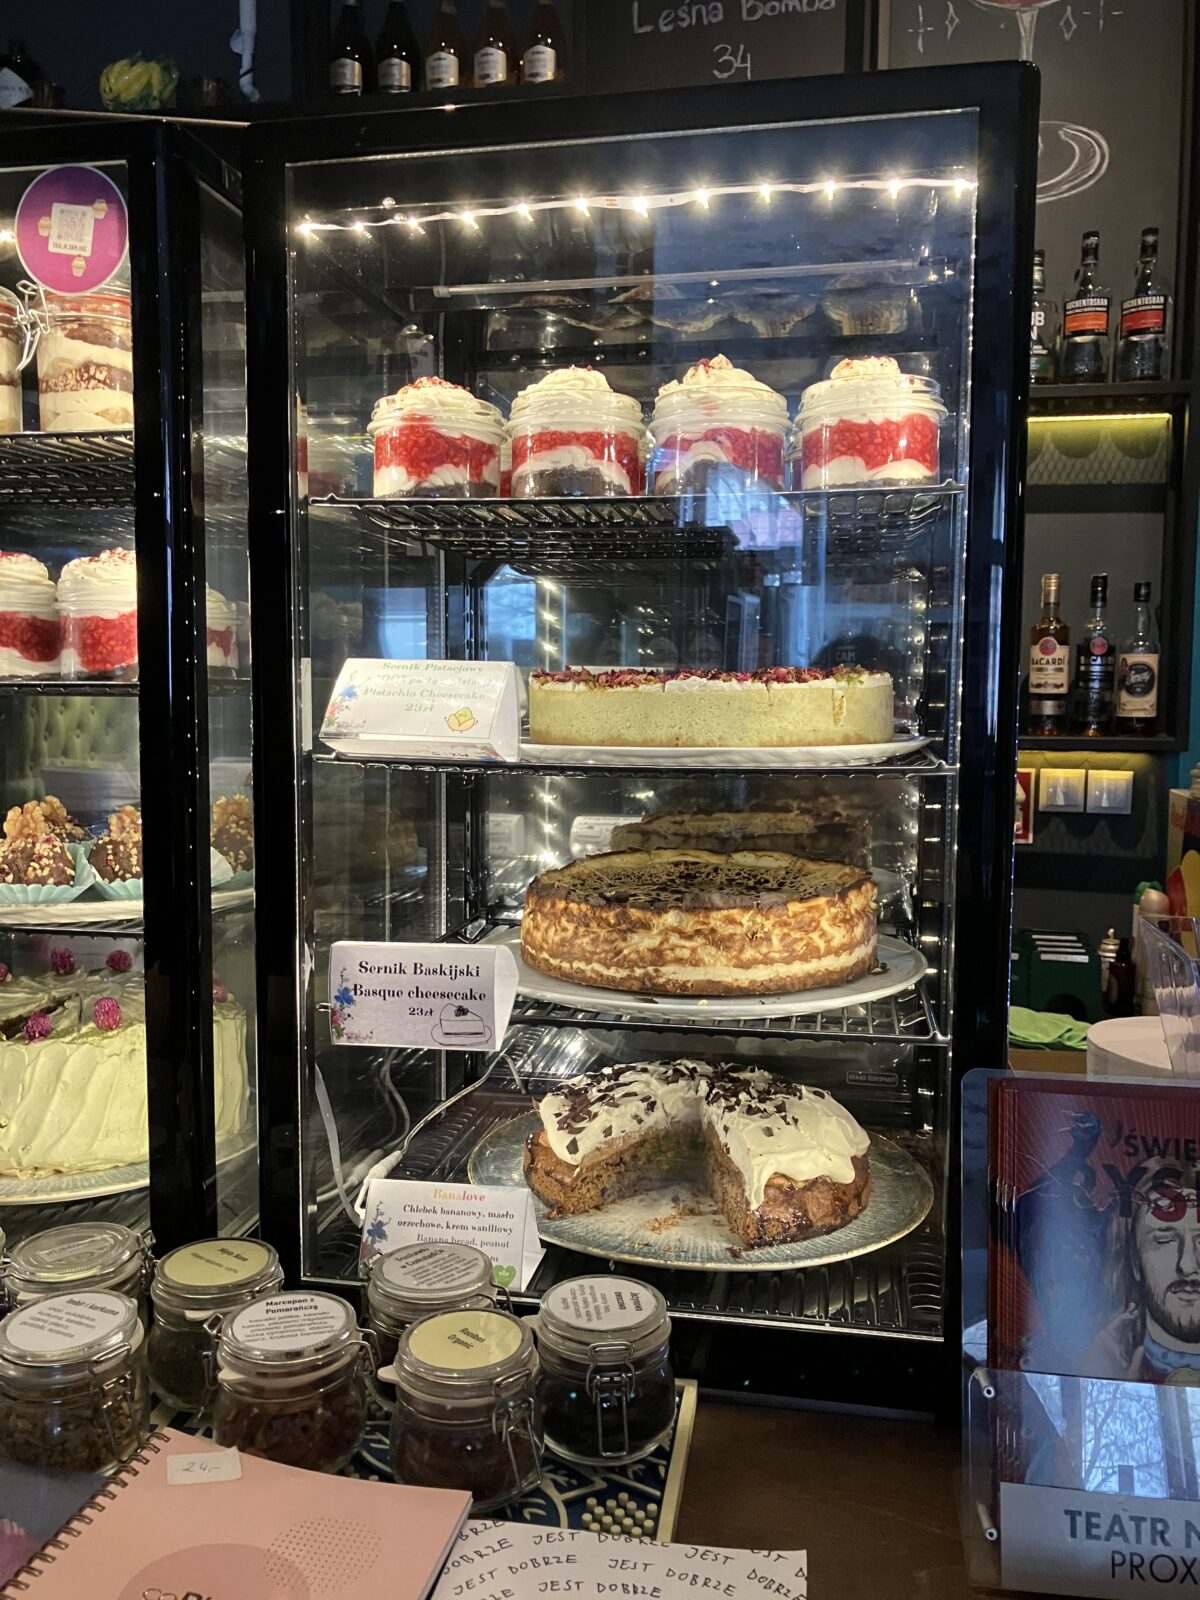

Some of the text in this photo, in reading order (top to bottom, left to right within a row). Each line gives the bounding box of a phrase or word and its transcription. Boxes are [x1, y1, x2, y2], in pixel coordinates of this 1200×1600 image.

[632, 0, 724, 34] Leśna
[712, 44, 751, 80] 34
[364, 687, 486, 700] Pistachio Cheesecake
[359, 961, 480, 980] Sernik Baskijski
[353, 984, 486, 1001] Basque cheesecake
[409, 1006, 434, 1017] 23zł
[431, 1188, 486, 1201] Banalove
[403, 1204, 514, 1219] Chlebek bananowy, masło
[397, 1219, 444, 1230] orzechowe,
[445, 1221, 468, 1231] krem
[480, 1240, 509, 1249] peanut
[265, 1298, 308, 1307] Marcepan
[1064, 1509, 1172, 1547] TEATR
[533, 1531, 580, 1545] JEST
[684, 1547, 736, 1565] JEST
[452, 1568, 499, 1596] JEST
[508, 1554, 578, 1574] DOBRZE
[608, 1559, 655, 1572] JEST
[665, 1568, 736, 1597] DOBRZE
[1111, 1550, 1198, 1585] PROX
[538, 1580, 662, 1598] JEST DOBRZE
